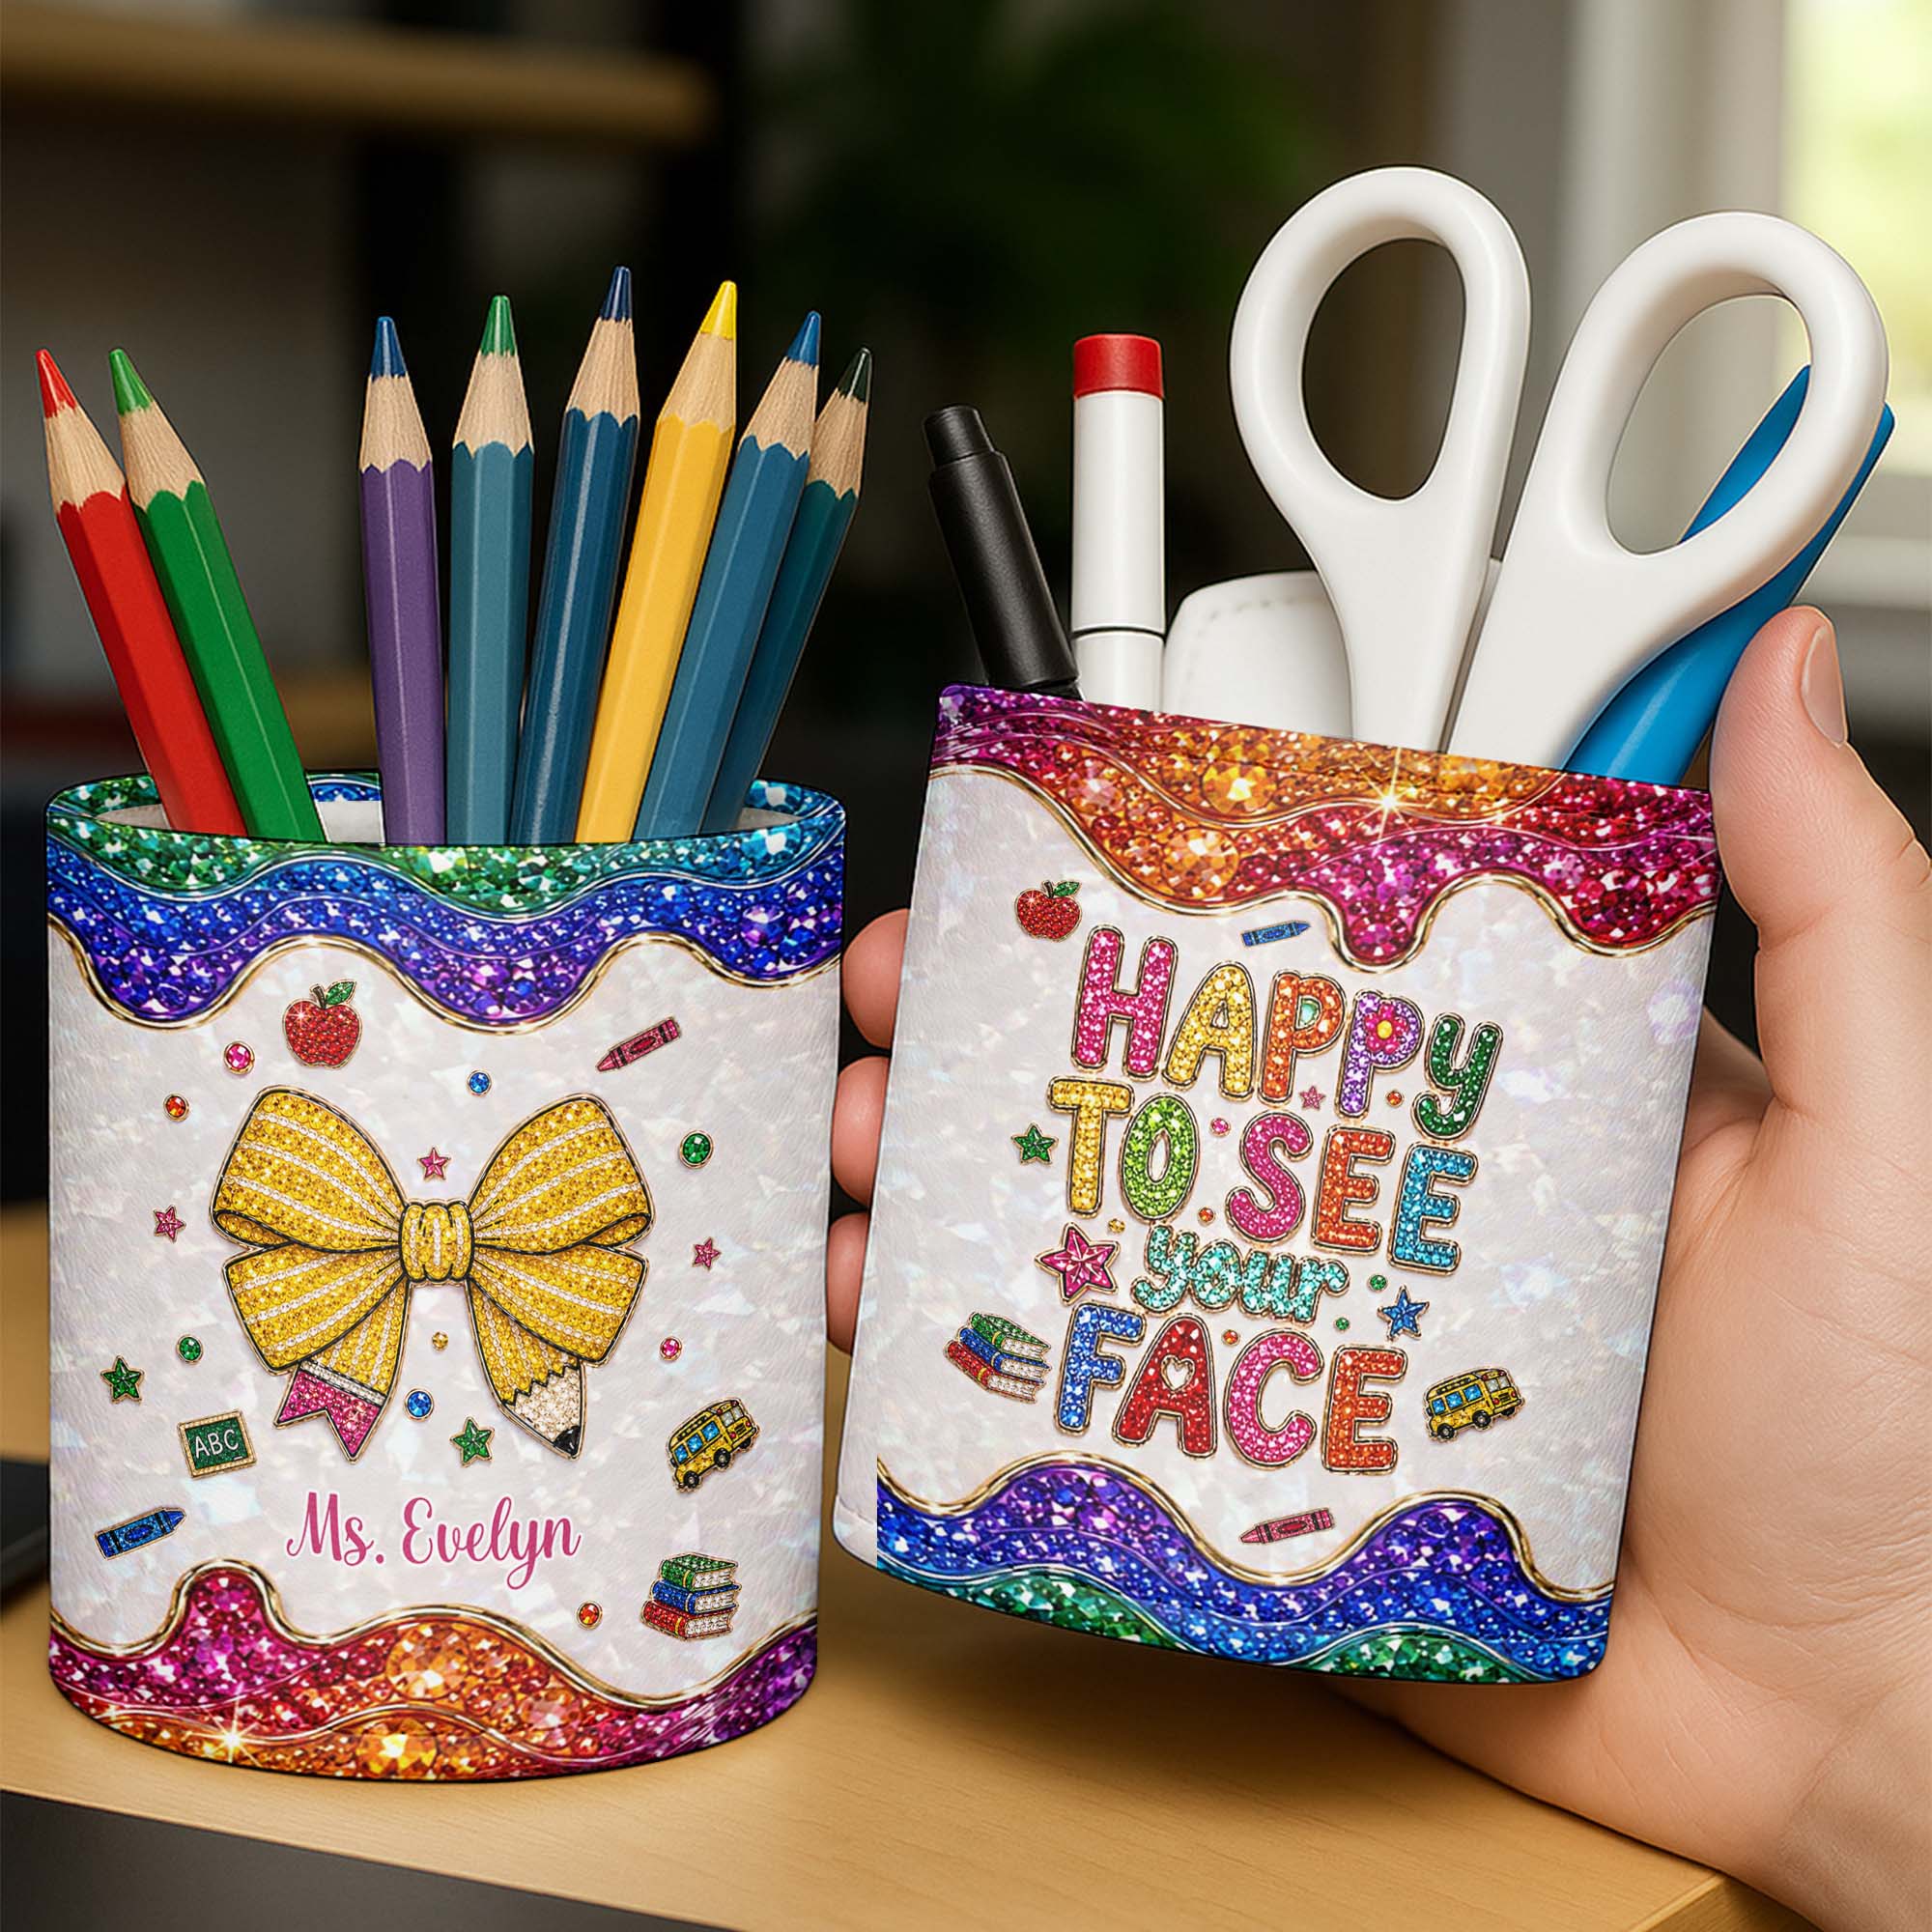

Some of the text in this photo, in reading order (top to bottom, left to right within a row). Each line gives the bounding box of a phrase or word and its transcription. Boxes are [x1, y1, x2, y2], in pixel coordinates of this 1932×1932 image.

[1048, 1076, 1478, 1275] TO SEE
[1131, 1224, 1350, 1324] your
[1054, 1301, 1406, 1474] FACE
[194, 1429, 239, 1459] ABC
[287, 1492, 582, 1590] Ms. Evelyn
